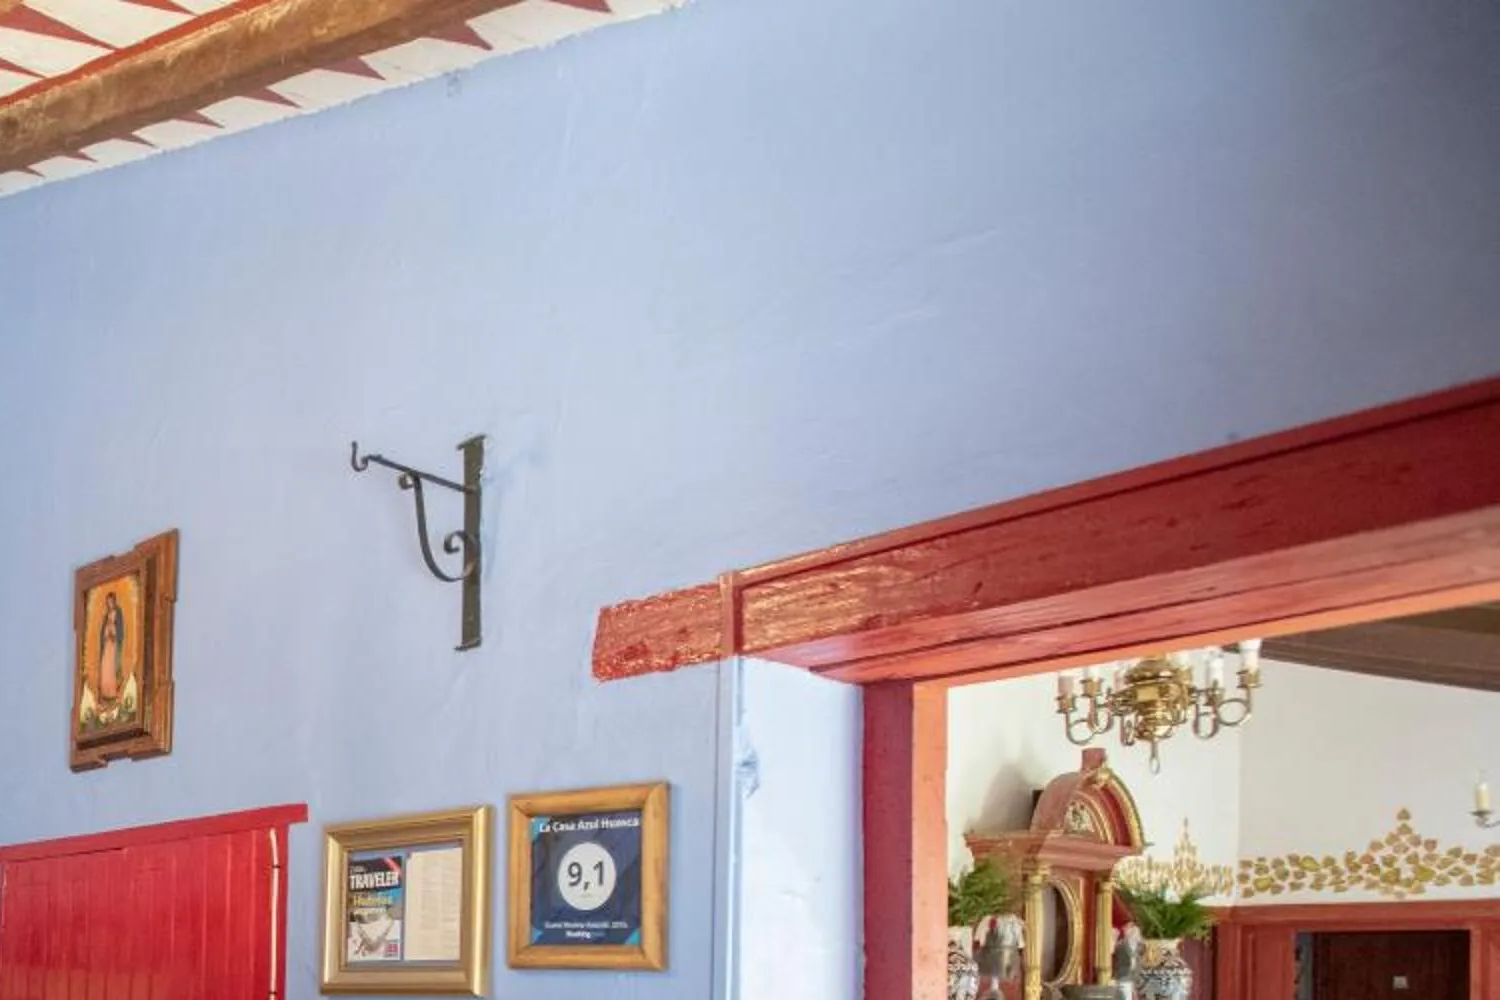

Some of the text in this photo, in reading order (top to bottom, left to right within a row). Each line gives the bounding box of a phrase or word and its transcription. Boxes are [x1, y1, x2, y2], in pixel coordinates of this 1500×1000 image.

[578, 818, 599, 830] Azul
[349, 871, 399, 891] TRAVELER
[567, 860, 605, 891] 9,1
